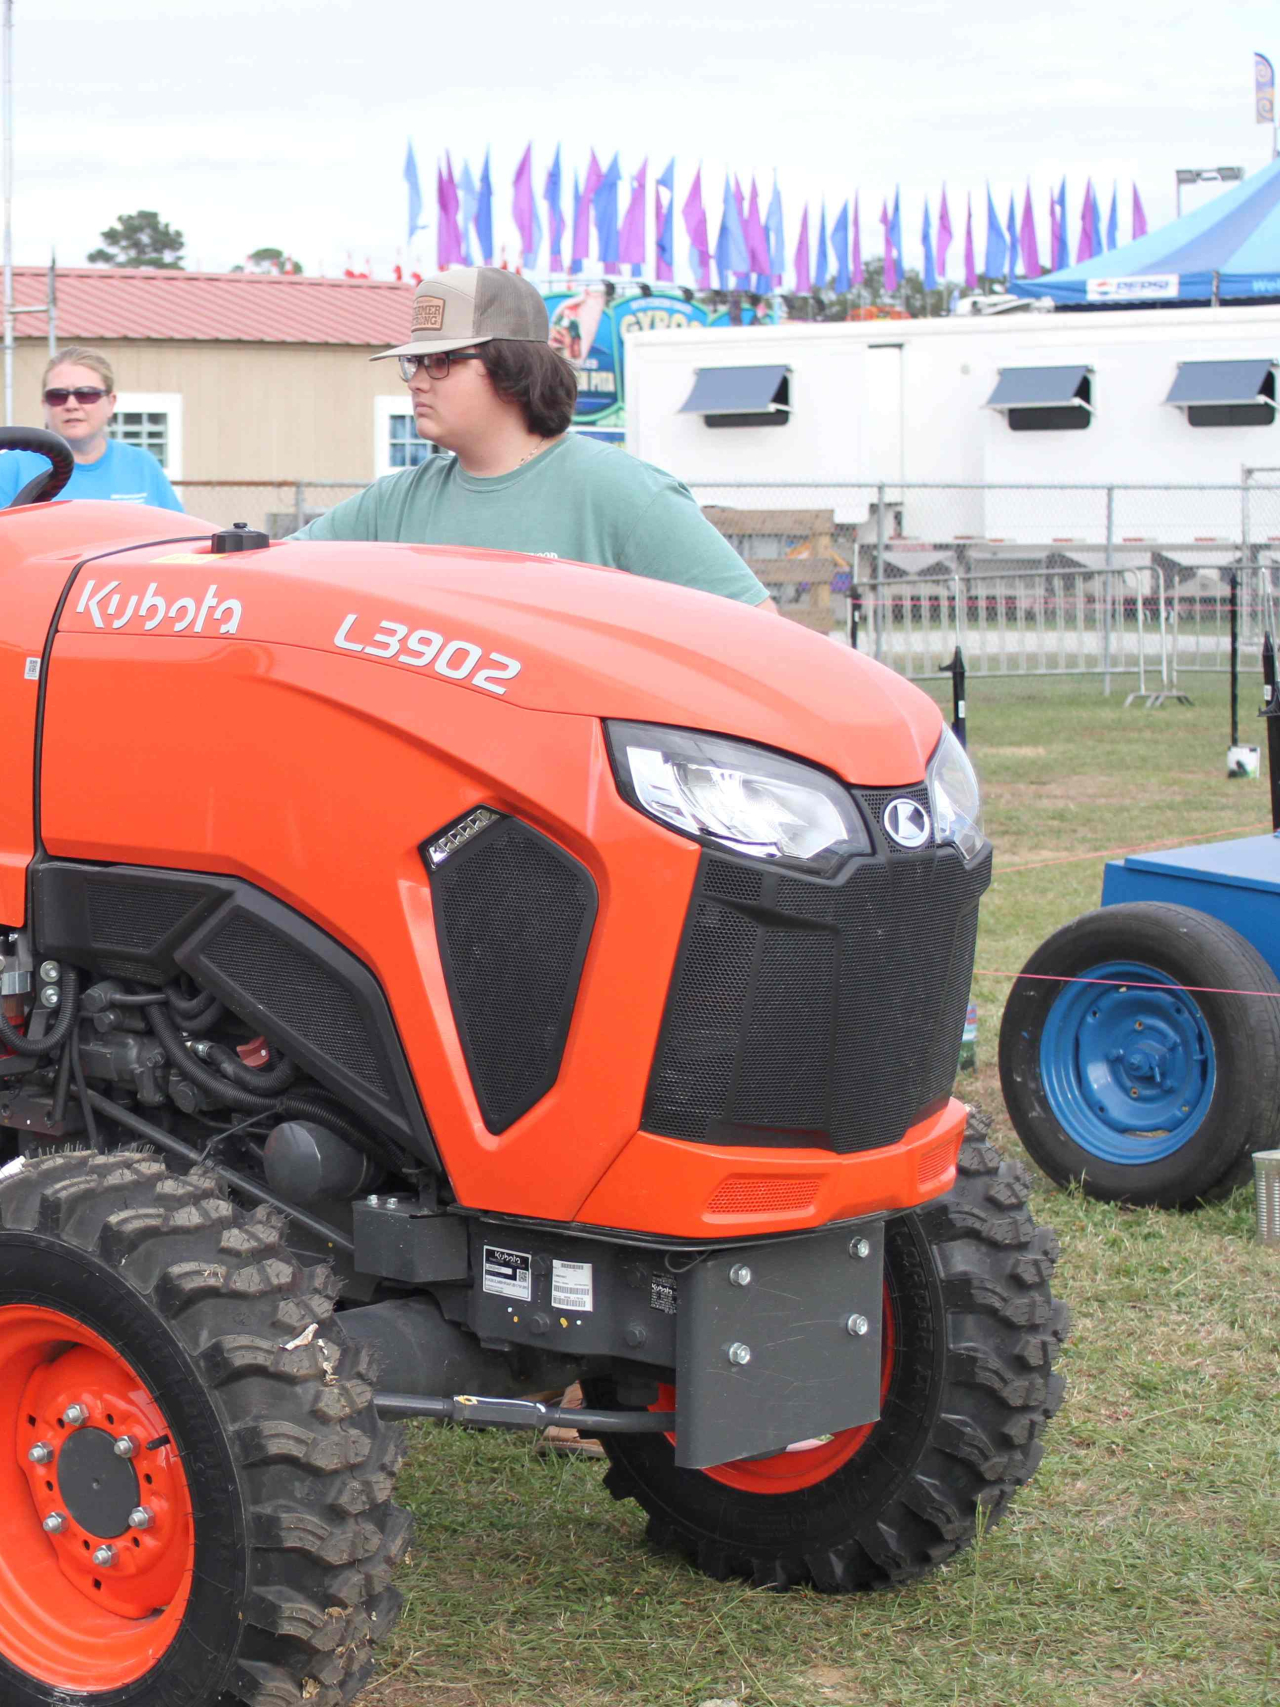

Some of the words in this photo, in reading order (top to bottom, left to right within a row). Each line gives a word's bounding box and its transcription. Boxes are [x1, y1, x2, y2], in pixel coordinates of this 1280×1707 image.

[76, 580, 242, 634] Kubota
[333, 613, 522, 695] L3902
[494, 1251, 521, 1264] Kubota
